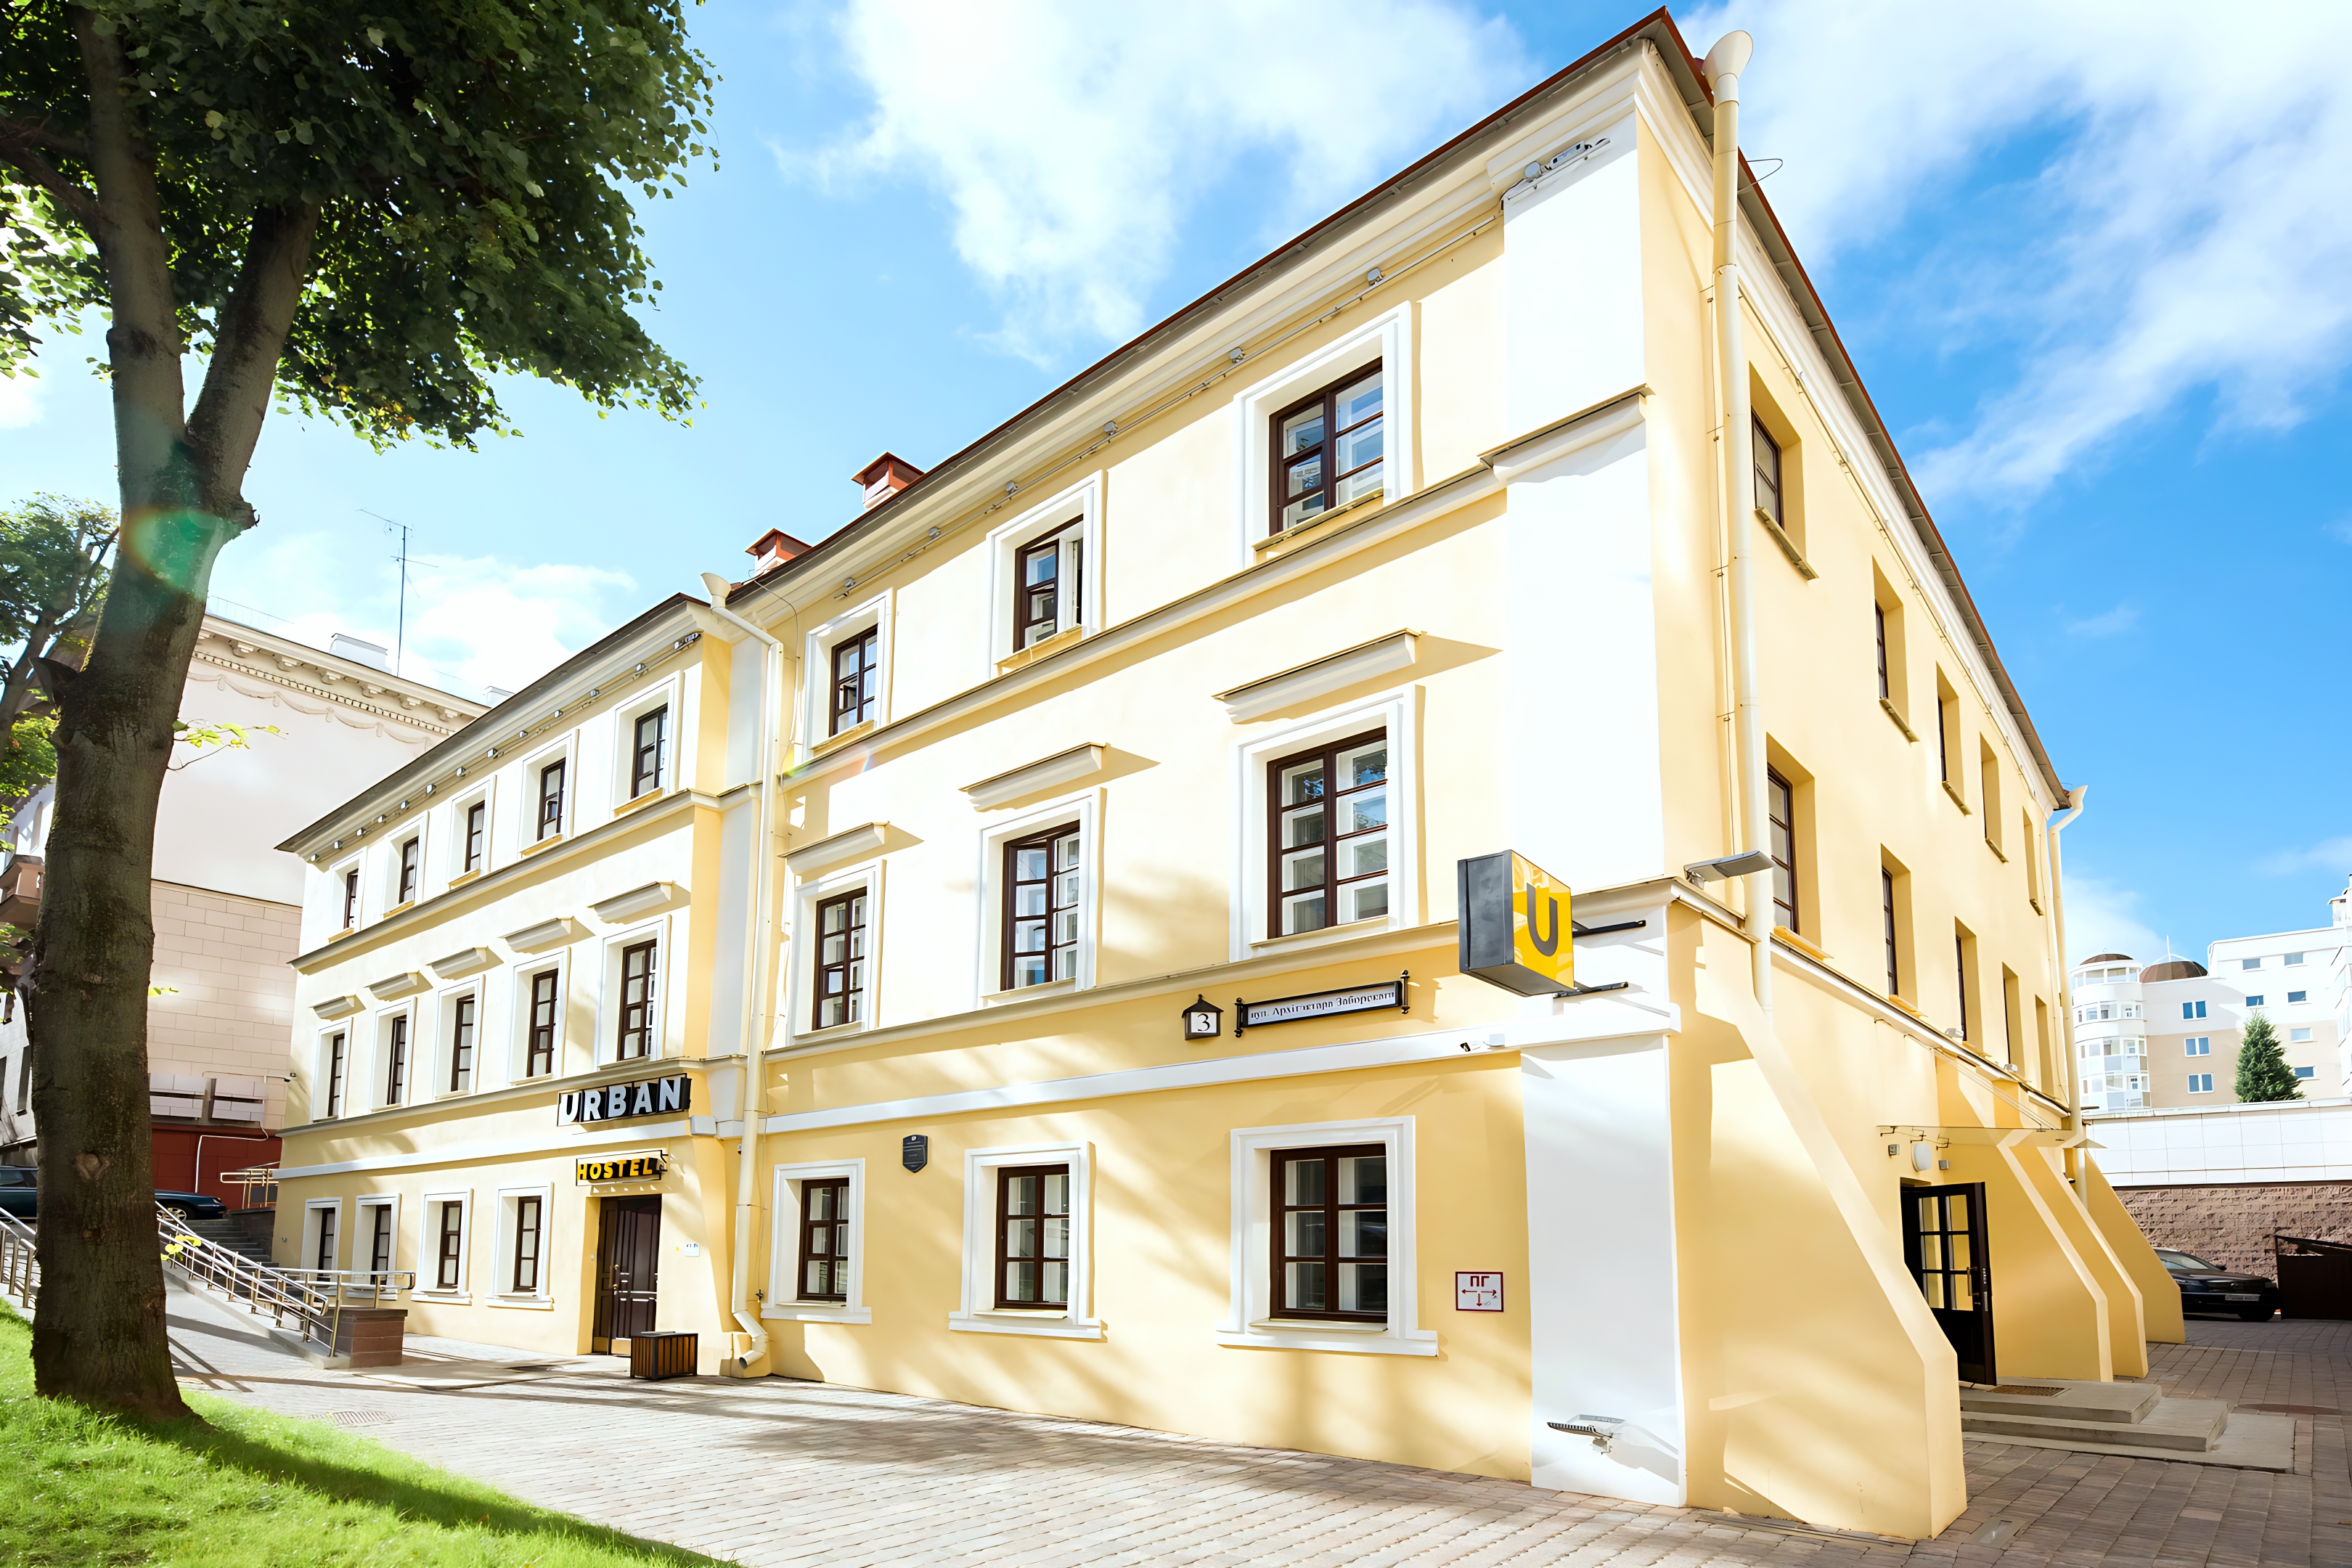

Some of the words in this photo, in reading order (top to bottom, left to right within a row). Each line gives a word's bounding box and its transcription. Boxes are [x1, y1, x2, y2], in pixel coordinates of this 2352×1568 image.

[1527, 883, 1559, 957] U
[1197, 1013, 1210, 1032] 3
[558, 1077, 682, 1126] URBAN
[577, 1157, 653, 1180] HOSTEL
[1470, 1275, 1490, 1287] ПГ
